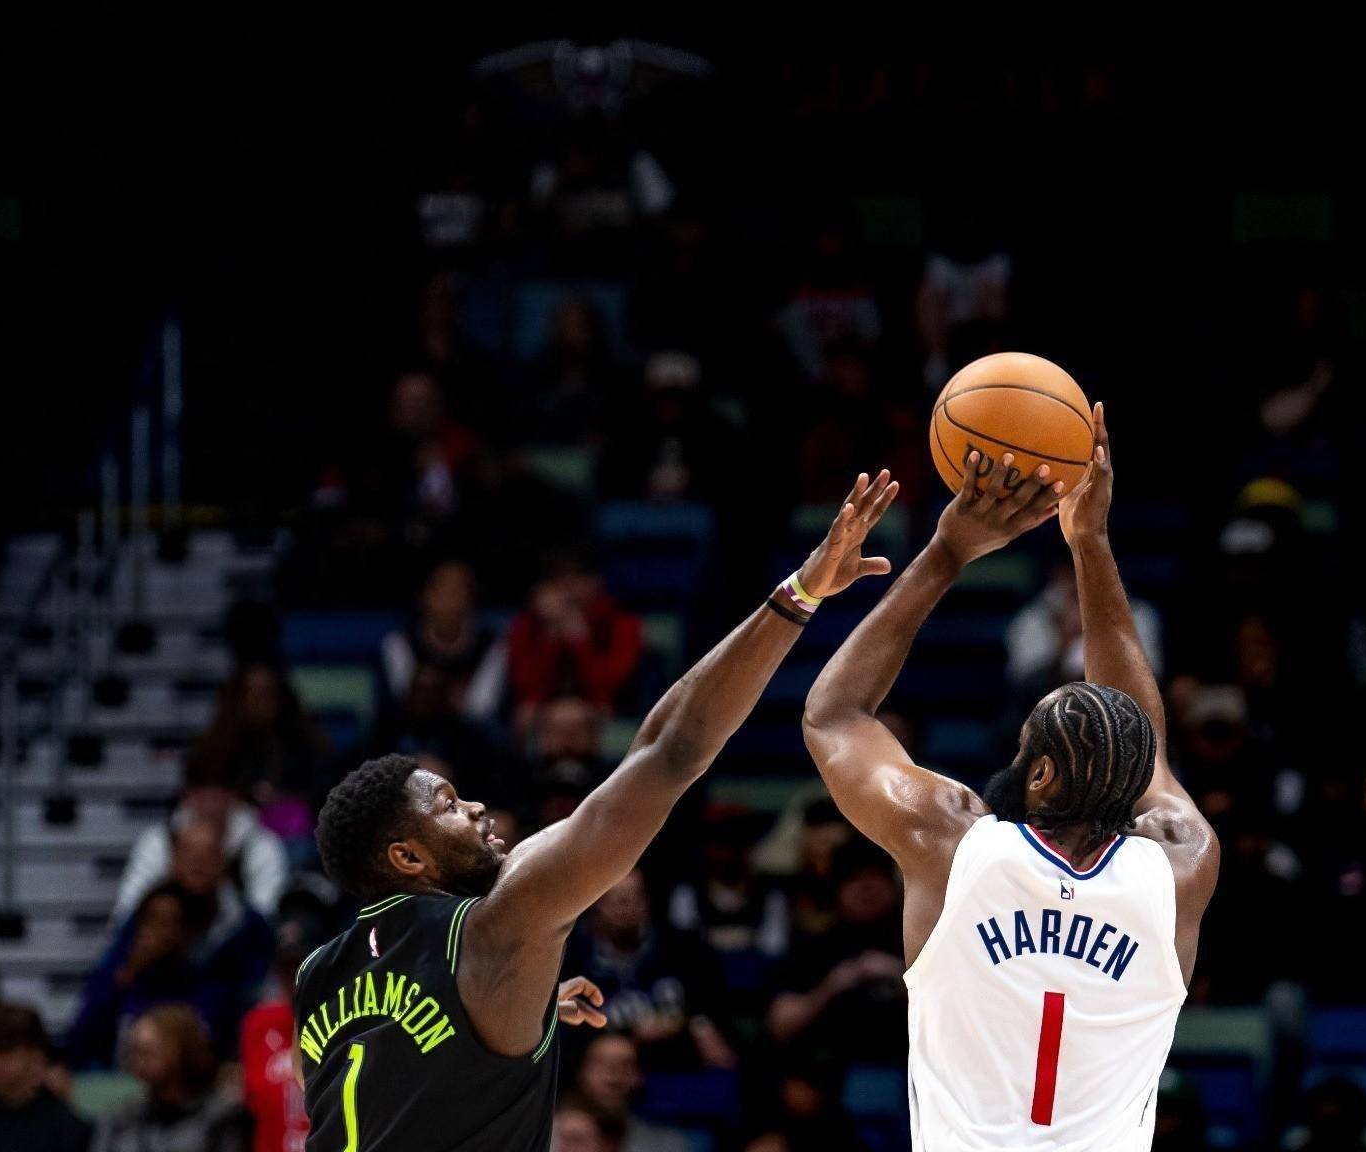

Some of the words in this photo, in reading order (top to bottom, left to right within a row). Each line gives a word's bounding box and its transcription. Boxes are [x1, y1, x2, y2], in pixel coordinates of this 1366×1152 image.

[976, 908, 1139, 981] HARDEN
[300, 971, 456, 1065] WILLIAMSON
[1031, 991, 1065, 1126] 1
